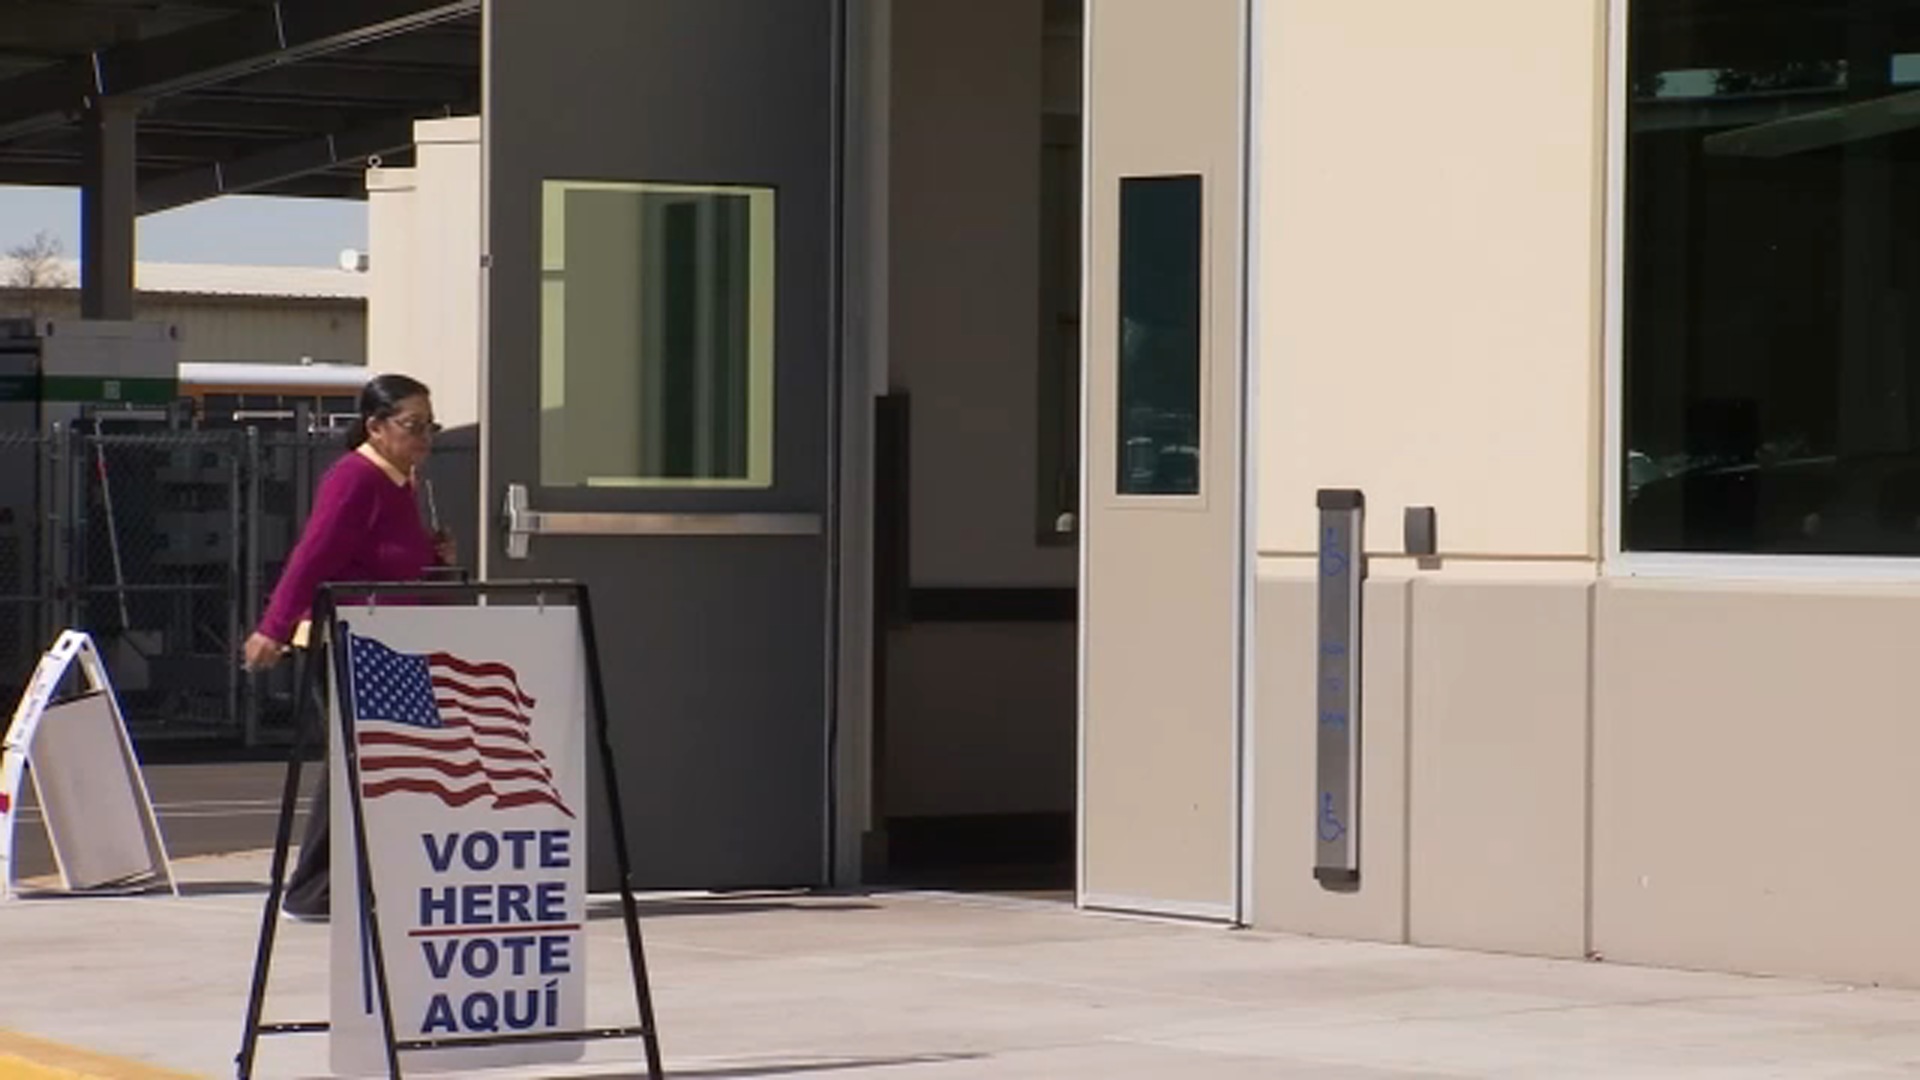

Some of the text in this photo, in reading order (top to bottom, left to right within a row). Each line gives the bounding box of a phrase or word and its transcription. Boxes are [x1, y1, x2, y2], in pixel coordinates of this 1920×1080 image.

[421, 830, 570, 872] VOTE
[420, 882, 566, 926] HERE
[421, 936, 570, 979] VOTE
[420, 979, 558, 1033] AQUÍ
